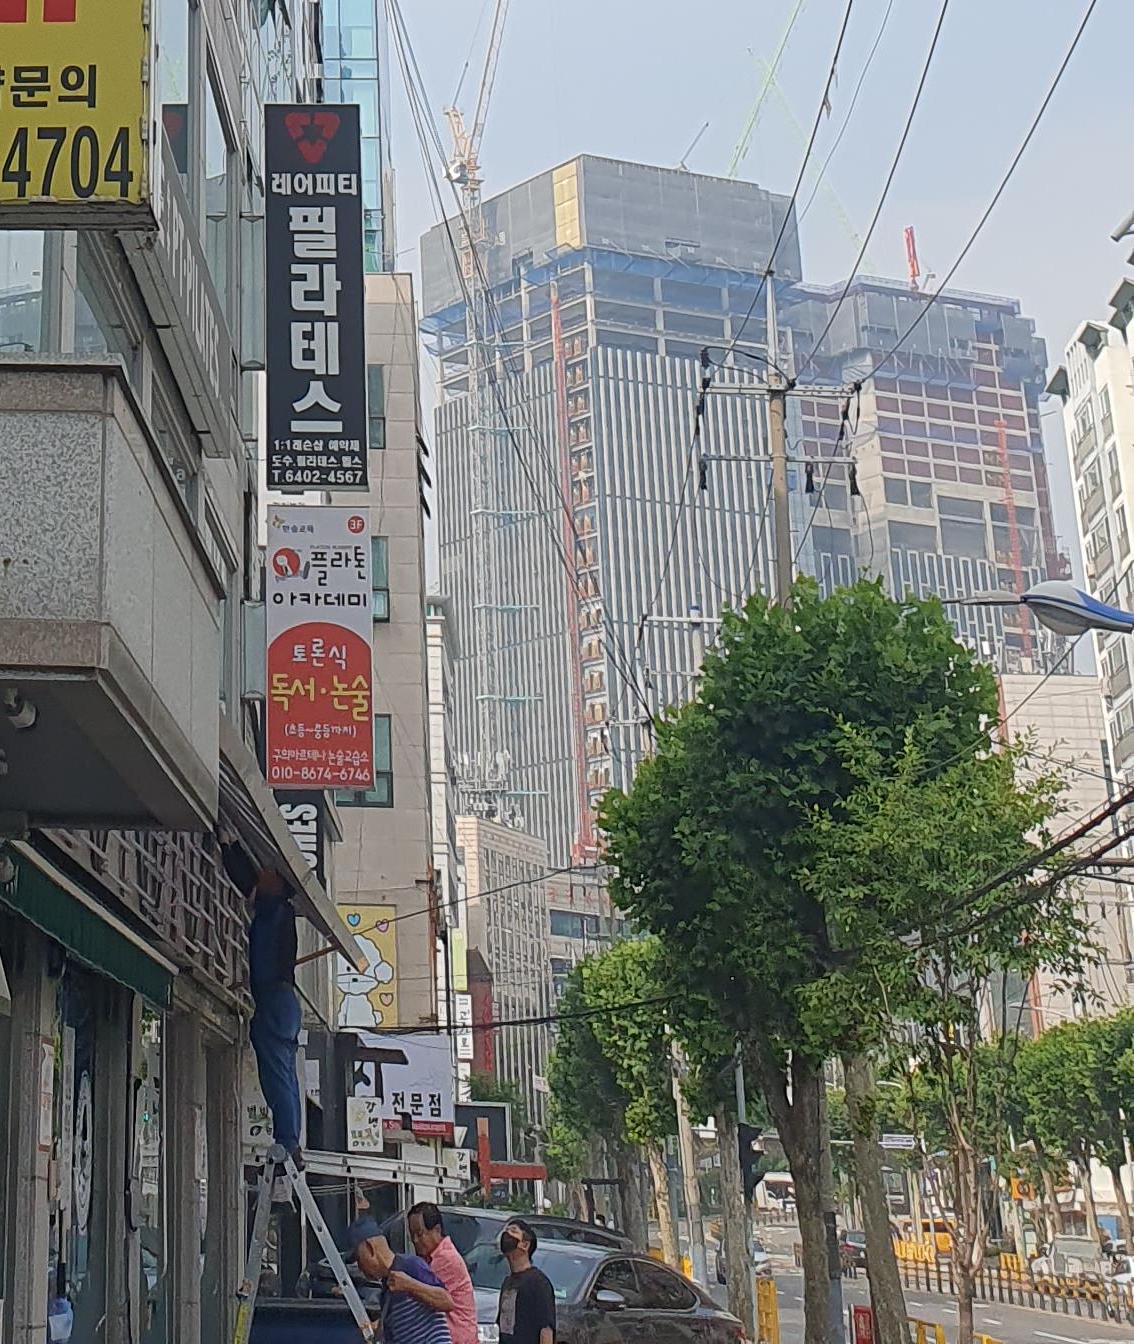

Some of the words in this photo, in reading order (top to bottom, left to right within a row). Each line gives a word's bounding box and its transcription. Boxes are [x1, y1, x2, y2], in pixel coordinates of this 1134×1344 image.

[271, 173, 358, 196] 레어피티
[288, 205, 343, 433] 필라테스
[271, 469, 363, 483] T.6402-4567
[311, 545, 367, 587] 플라톤
[272, 592, 367, 607] 아카데미
[292, 638, 347, 670] 토론식
[271, 766, 371, 781] 010-8674-6746
[392, 1091, 442, 1118] 전문점
